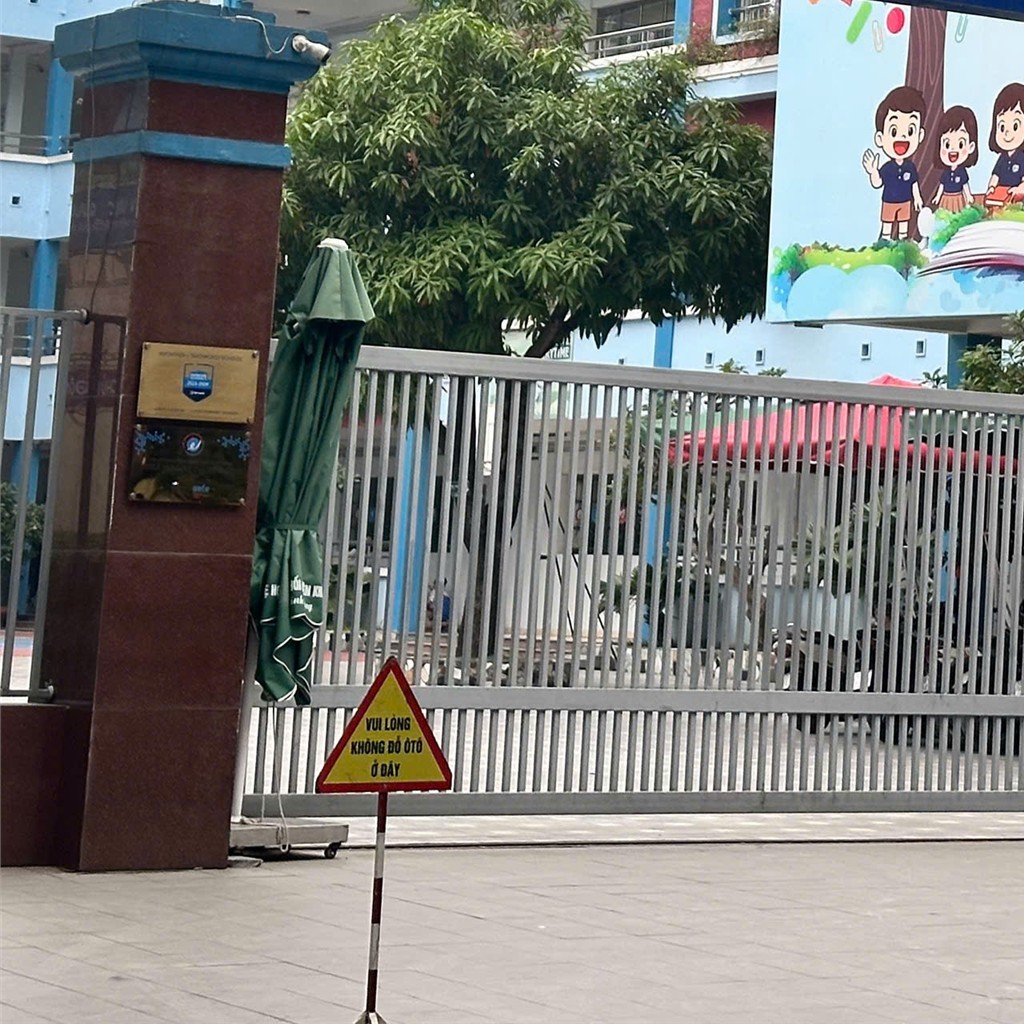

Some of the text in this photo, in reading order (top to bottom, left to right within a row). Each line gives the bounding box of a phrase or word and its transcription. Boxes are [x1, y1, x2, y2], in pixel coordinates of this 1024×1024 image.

[366, 714, 411, 731] VUI LÒNG
[351, 738, 385, 754] KHÔNG
[371, 759, 400, 777] Ở ĐÂY
